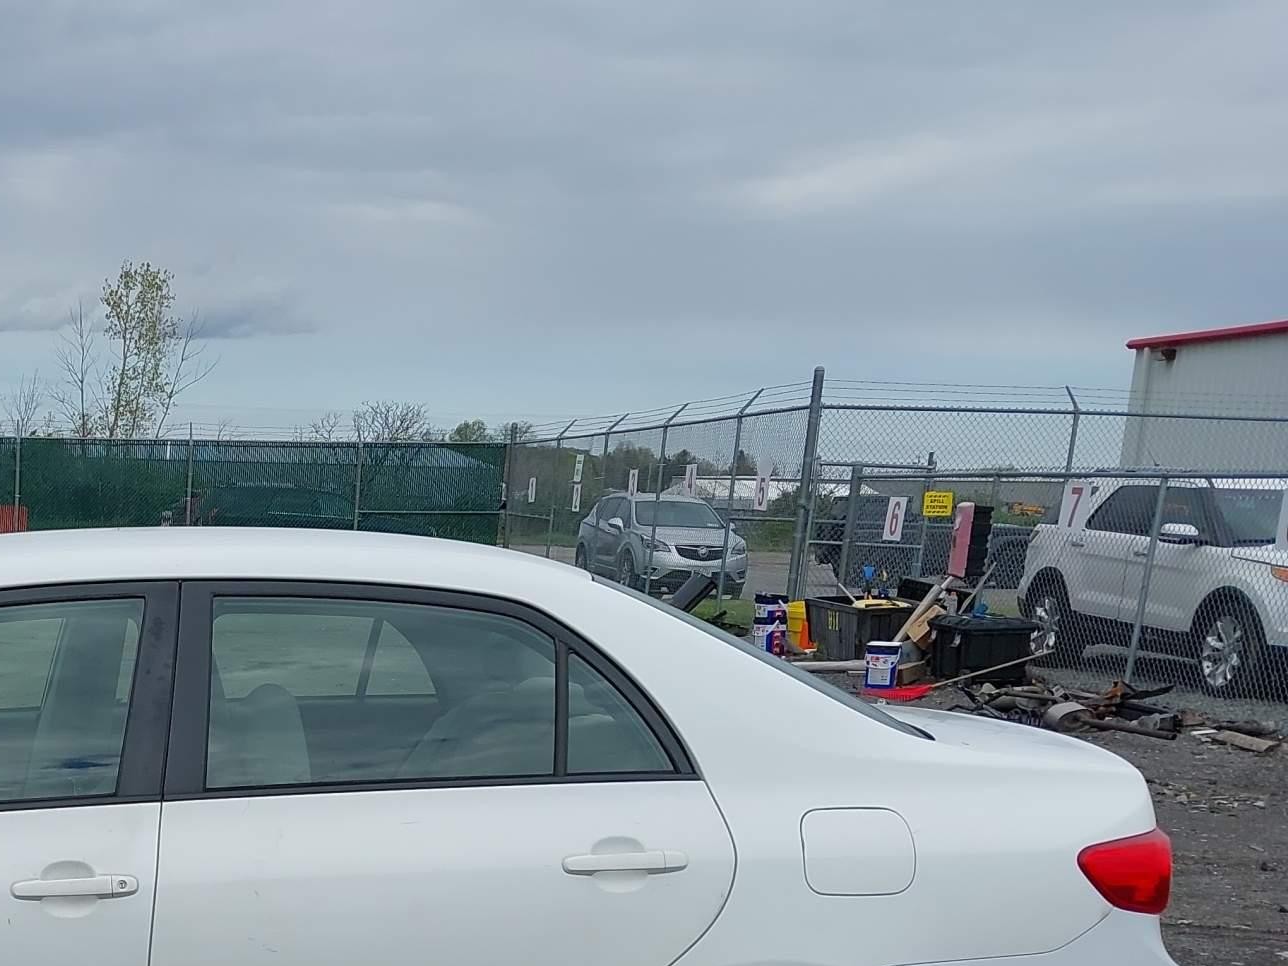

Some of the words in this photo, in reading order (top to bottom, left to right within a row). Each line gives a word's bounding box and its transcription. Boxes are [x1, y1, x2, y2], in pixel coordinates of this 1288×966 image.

[758, 477, 765, 507] 5
[1067, 487, 1084, 528] 7
[889, 501, 901, 537] 6
